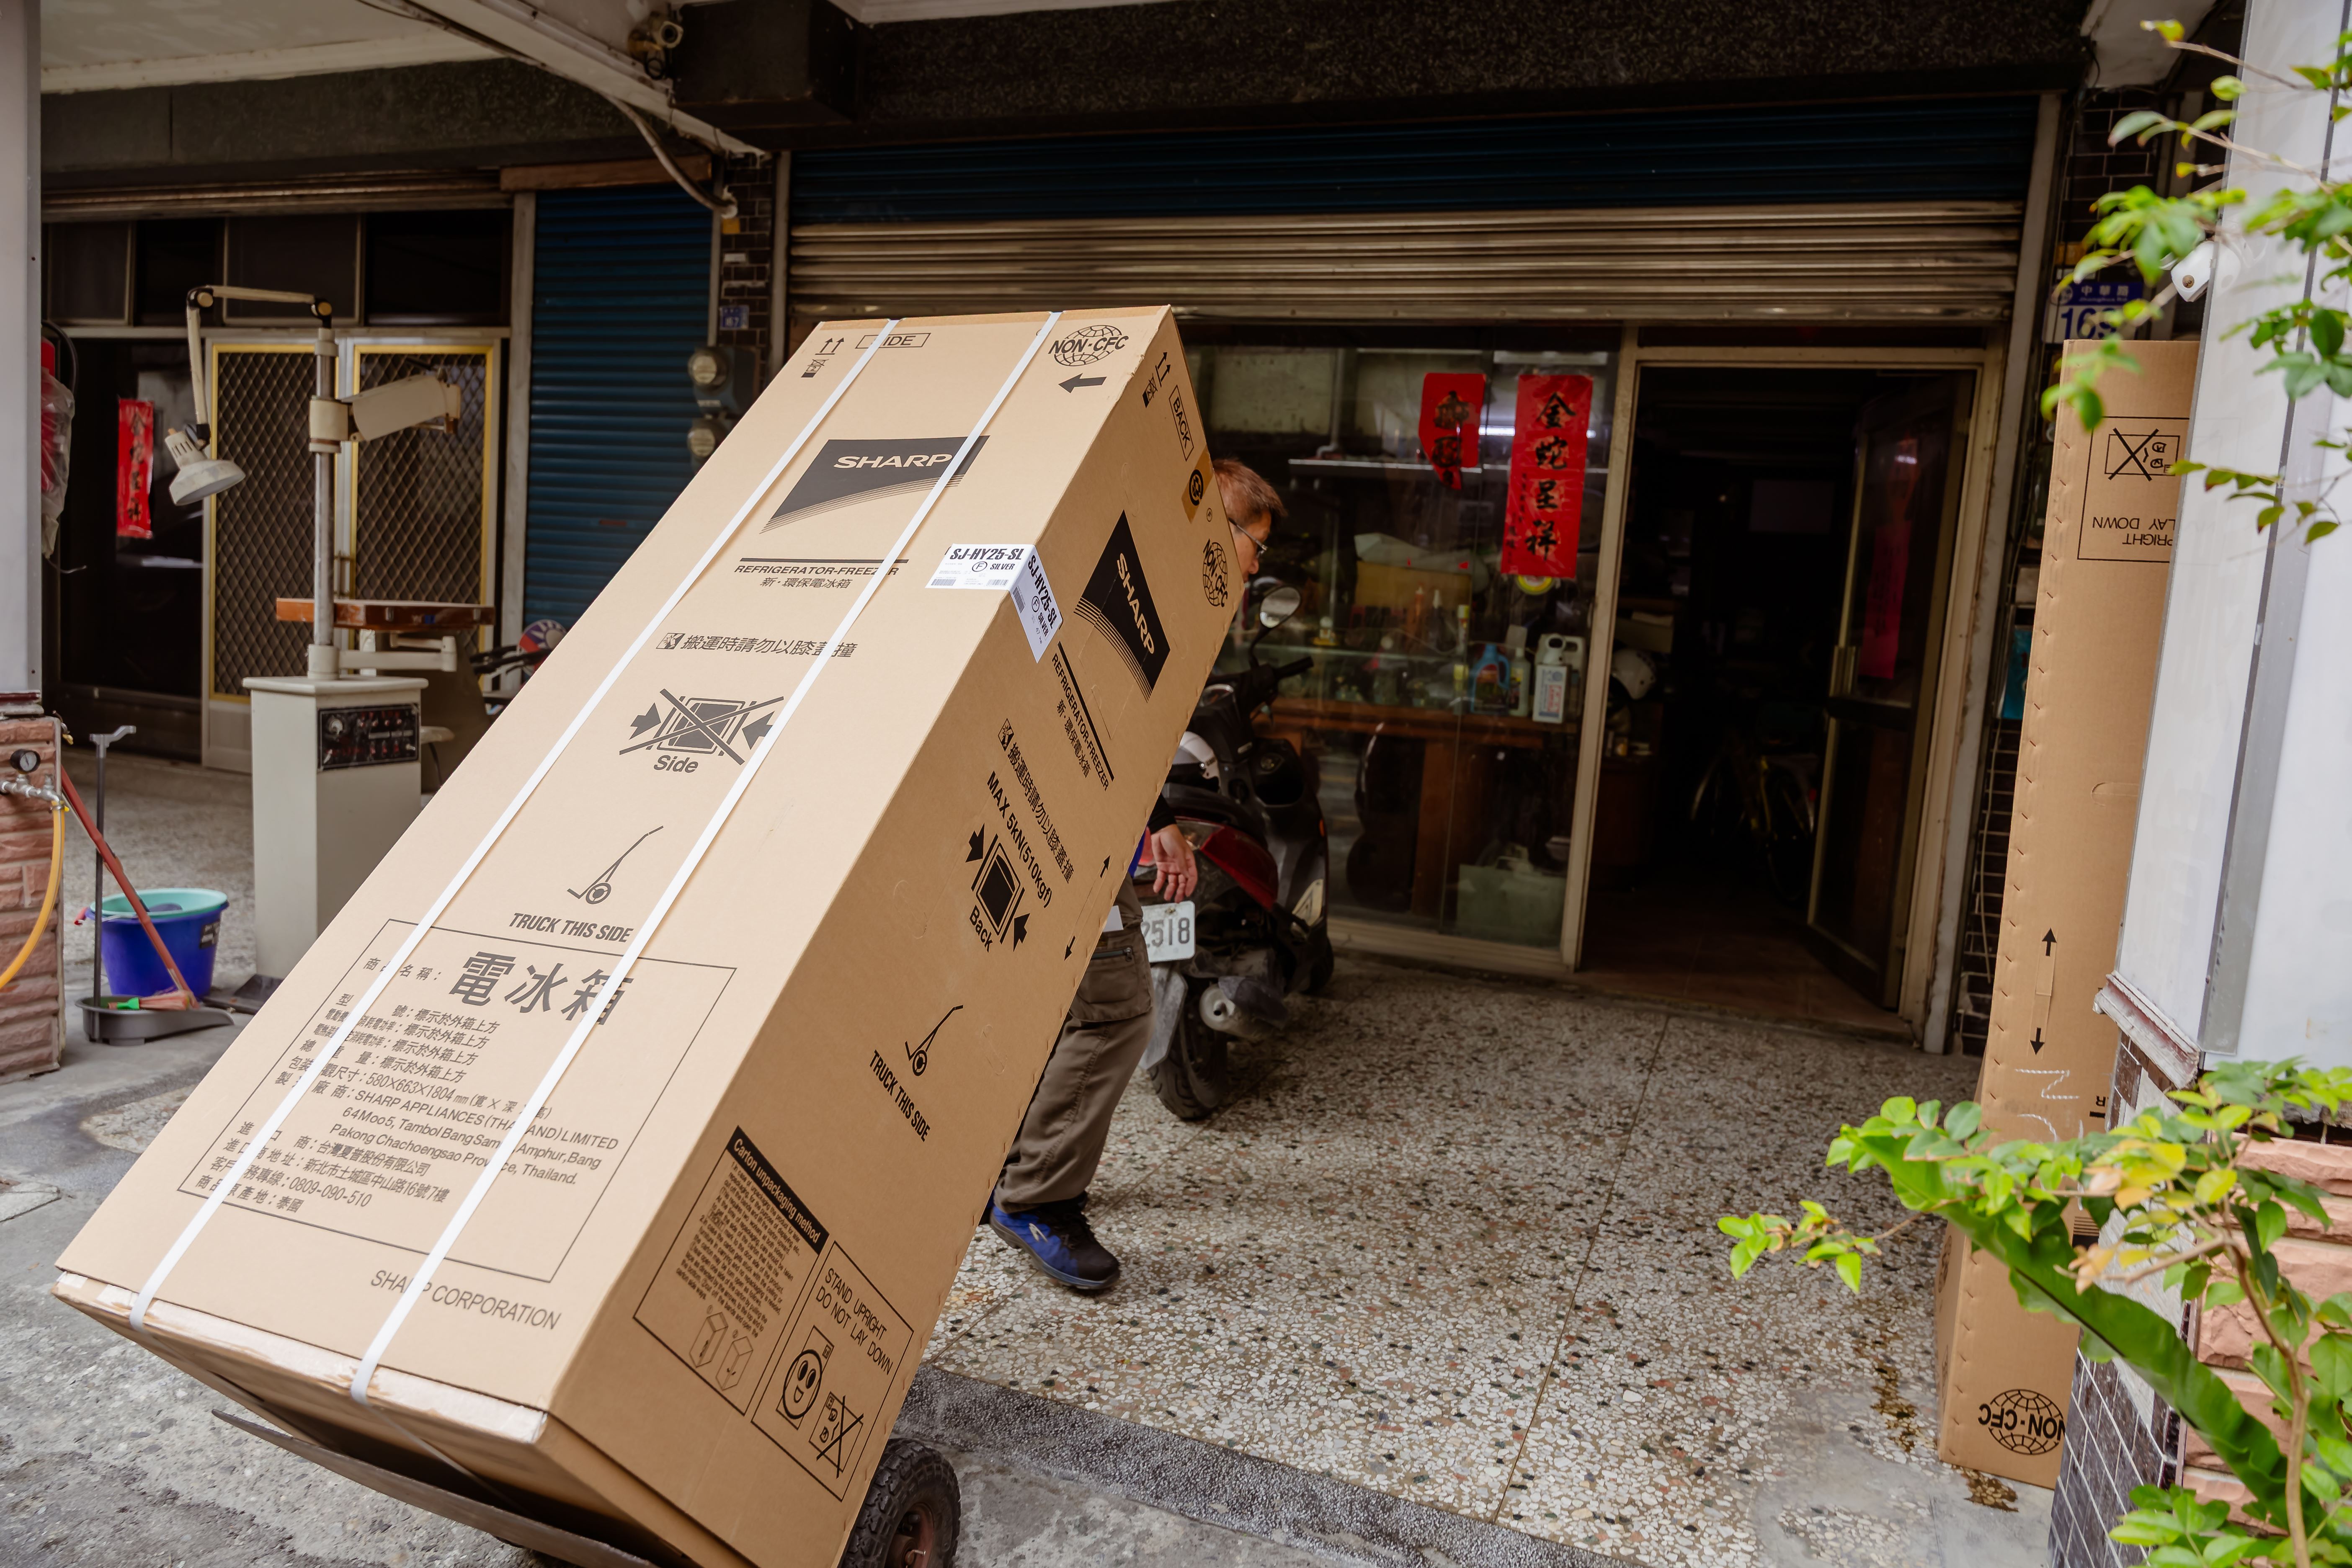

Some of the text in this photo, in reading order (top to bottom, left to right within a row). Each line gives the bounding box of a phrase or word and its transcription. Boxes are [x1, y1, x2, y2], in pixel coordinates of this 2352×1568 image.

[882, 335, 916, 346] IDE
[1173, 396, 1190, 449] BACK
[834, 454, 953, 469] SHARP
[1525, 392, 1576, 561] 金蛇呈祥
[2093, 517, 2176, 530] LAY DOWN
[734, 566, 900, 575] REFRIGERATOR-FREEZR
[950, 549, 1024, 560] SJ-HY25-SL
[1028, 555, 1057, 629] SJ-HY25-SL
[1117, 553, 1155, 654] SHARP
[1038, 612, 1049, 637] SILVER
[1051, 652, 1109, 792] REFRIGERATOR-FREEZER
[653, 755, 699, 773] Side
[1007, 742, 1075, 884] 搬運時請勿以膝蓋撞
[987, 770, 1052, 908] MAX 5kN(510kgf)
[509, 913, 634, 943] TRUCK THIS SIDE
[969, 904, 993, 953] Back
[449, 952, 634, 1027] 電冰箱
[404, 1023, 490, 1049] 標示於外箱上方
[415, 1008, 500, 1034] 標示於外箱上方
[380, 1056, 467, 1083] 標示於外箱上方
[392, 1039, 478, 1065] 標示於外箱上方
[869, 1049, 931, 1142] TRUCK THIS SIDE
[355, 1091, 401, 1107] SHARP
[485, 1115, 562, 1140] (THAAND)
[561, 1131, 618, 1149] LIMITED
[317, 1141, 431, 1176] 台灣夏普股份有限公司
[330, 1124, 577, 1184] Pakong Chachoengsao Provce, Thailand.
[289, 1177, 372, 1207] 0809-090-510
[303, 1158, 449, 1202] 新北市土城區中山路16號7樓
[734, 1139, 820, 1243] Carton unpackaging method
[277, 1196, 304, 1212] 泰國
[371, 1270, 562, 1329] SHAP CORPORATION
[825, 1267, 887, 1341] STAND UPRIGHT
[816, 1286, 893, 1375] DO NOT LAY DOWN
